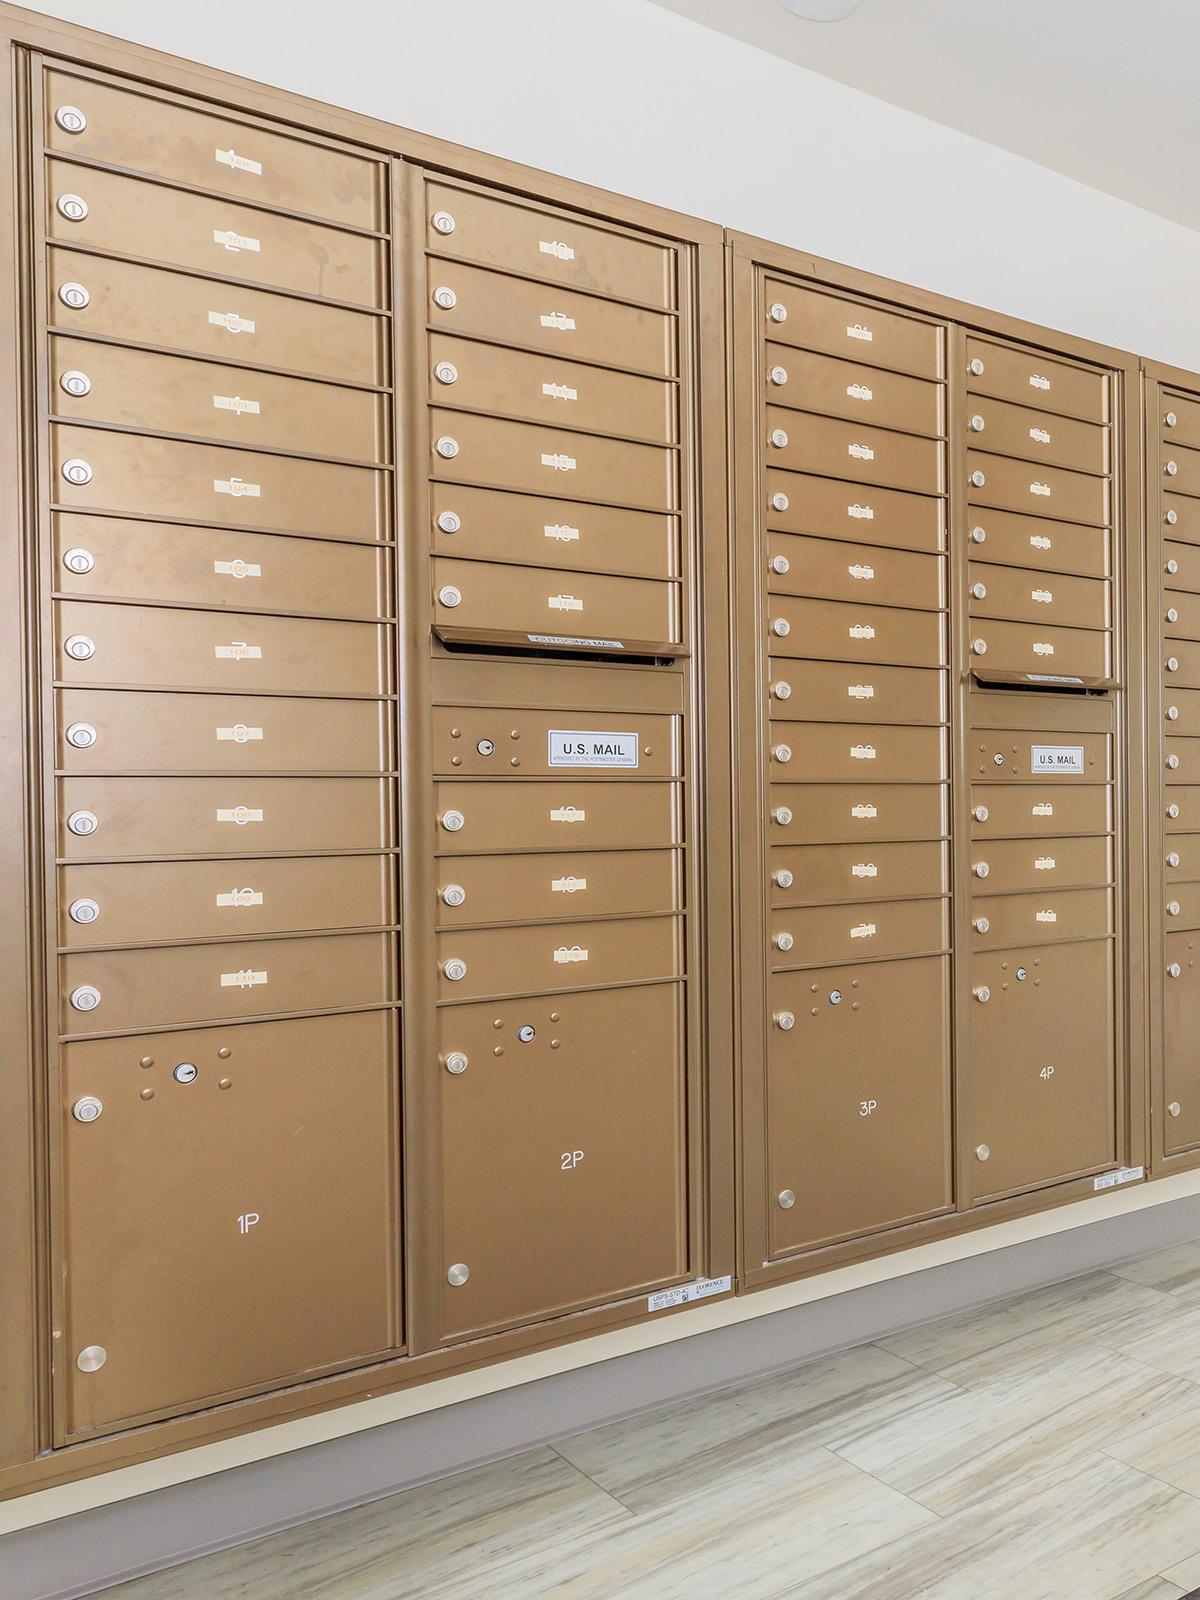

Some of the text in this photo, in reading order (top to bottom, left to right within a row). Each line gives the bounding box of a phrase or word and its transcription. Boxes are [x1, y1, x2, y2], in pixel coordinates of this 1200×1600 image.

[563, 743, 625, 756] U.S. MAIL
[1039, 755, 1076, 765] U.S. MAIL
[1040, 1067, 1054, 1079] 4P
[860, 1100, 876, 1116] 3P
[561, 1151, 583, 1169] 2P
[238, 1213, 259, 1233] 1P
